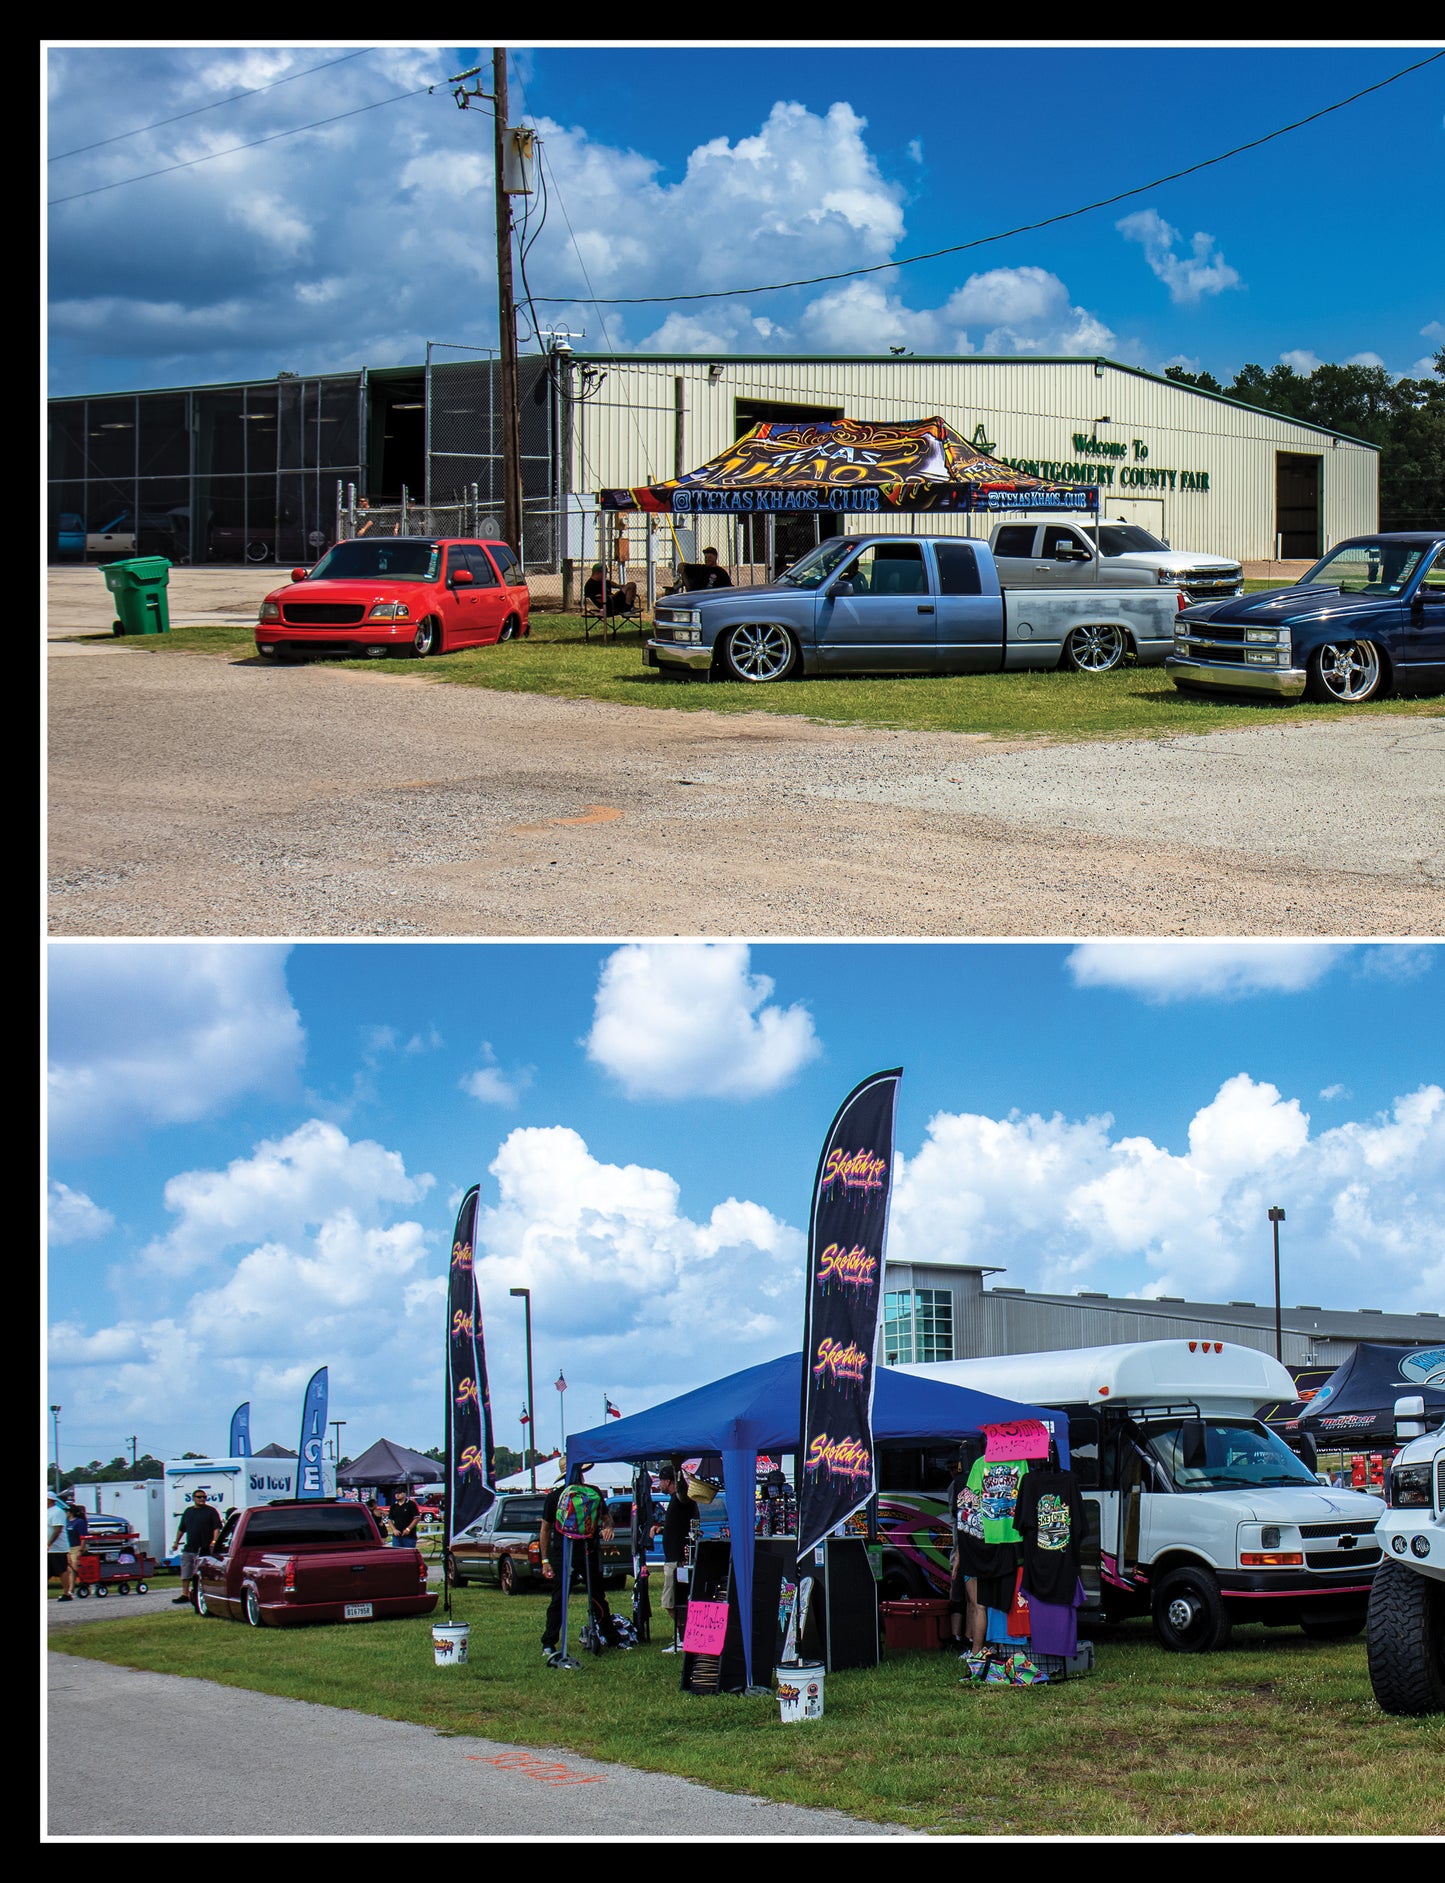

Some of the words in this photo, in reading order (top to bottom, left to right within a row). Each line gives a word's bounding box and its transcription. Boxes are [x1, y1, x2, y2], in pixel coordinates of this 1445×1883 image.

[771, 441, 882, 468] TEXAS
[1072, 432, 1128, 457] Welcome
[1133, 438, 1149, 458] To
[1002, 457, 1116, 485] MONTGOMERY
[1120, 465, 1178, 488] COUNTY
[1181, 470, 1211, 490] FAIR
[303, 1409, 322, 1490] ICE
